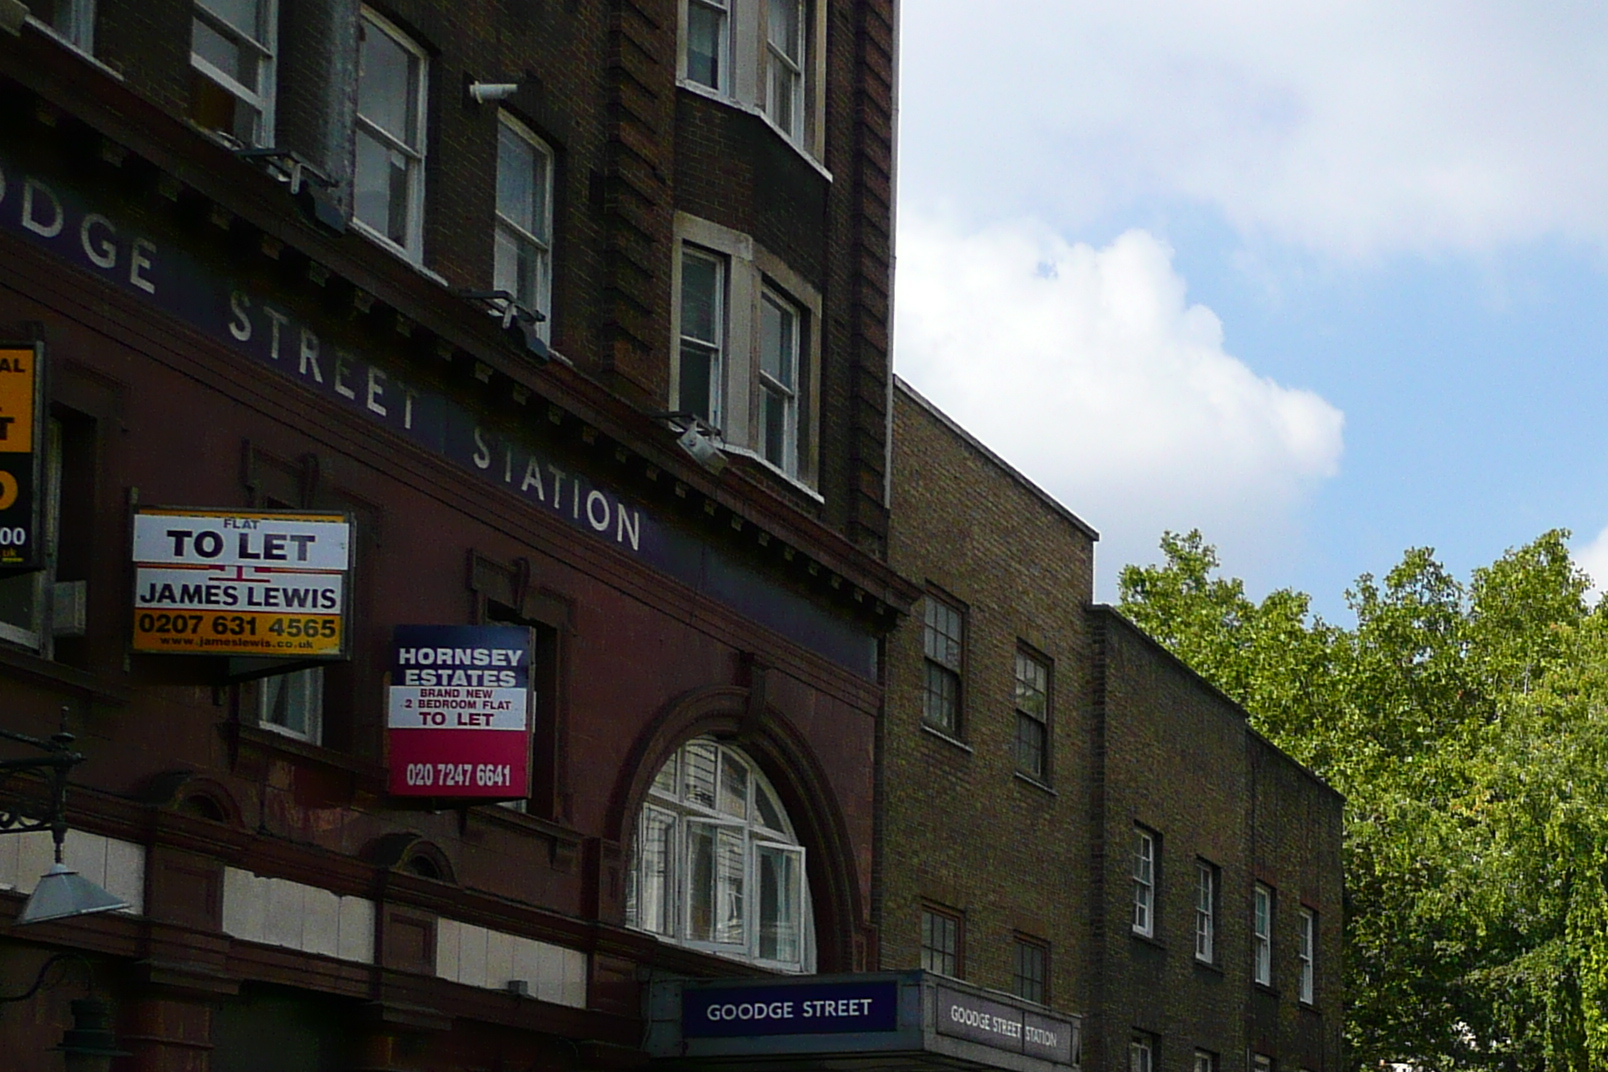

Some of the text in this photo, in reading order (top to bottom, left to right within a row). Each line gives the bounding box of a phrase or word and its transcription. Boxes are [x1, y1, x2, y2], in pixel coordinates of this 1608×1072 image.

[0, 165, 641, 551] DGE STREET STATION
[224, 518, 260, 529] FLAT
[167, 530, 316, 561] TO LET
[140, 583, 337, 609] JAMES LEWIS
[139, 613, 336, 639] 0207 631 4565
[160, 636, 314, 649] www.jameslewis.co.uk
[399, 648, 523, 667] HORNSEY
[405, 669, 517, 688] ESTATES
[420, 688, 493, 699] BRAND NEW
[405, 699, 512, 710] 2 BEDROOM FLAT
[419, 712, 495, 727] TO LET
[406, 763, 511, 786] 020 7247 6641
[706, 998, 873, 1022] GOODGE STREET
[951, 1004, 1058, 1048] GOODGE STREET STATION
